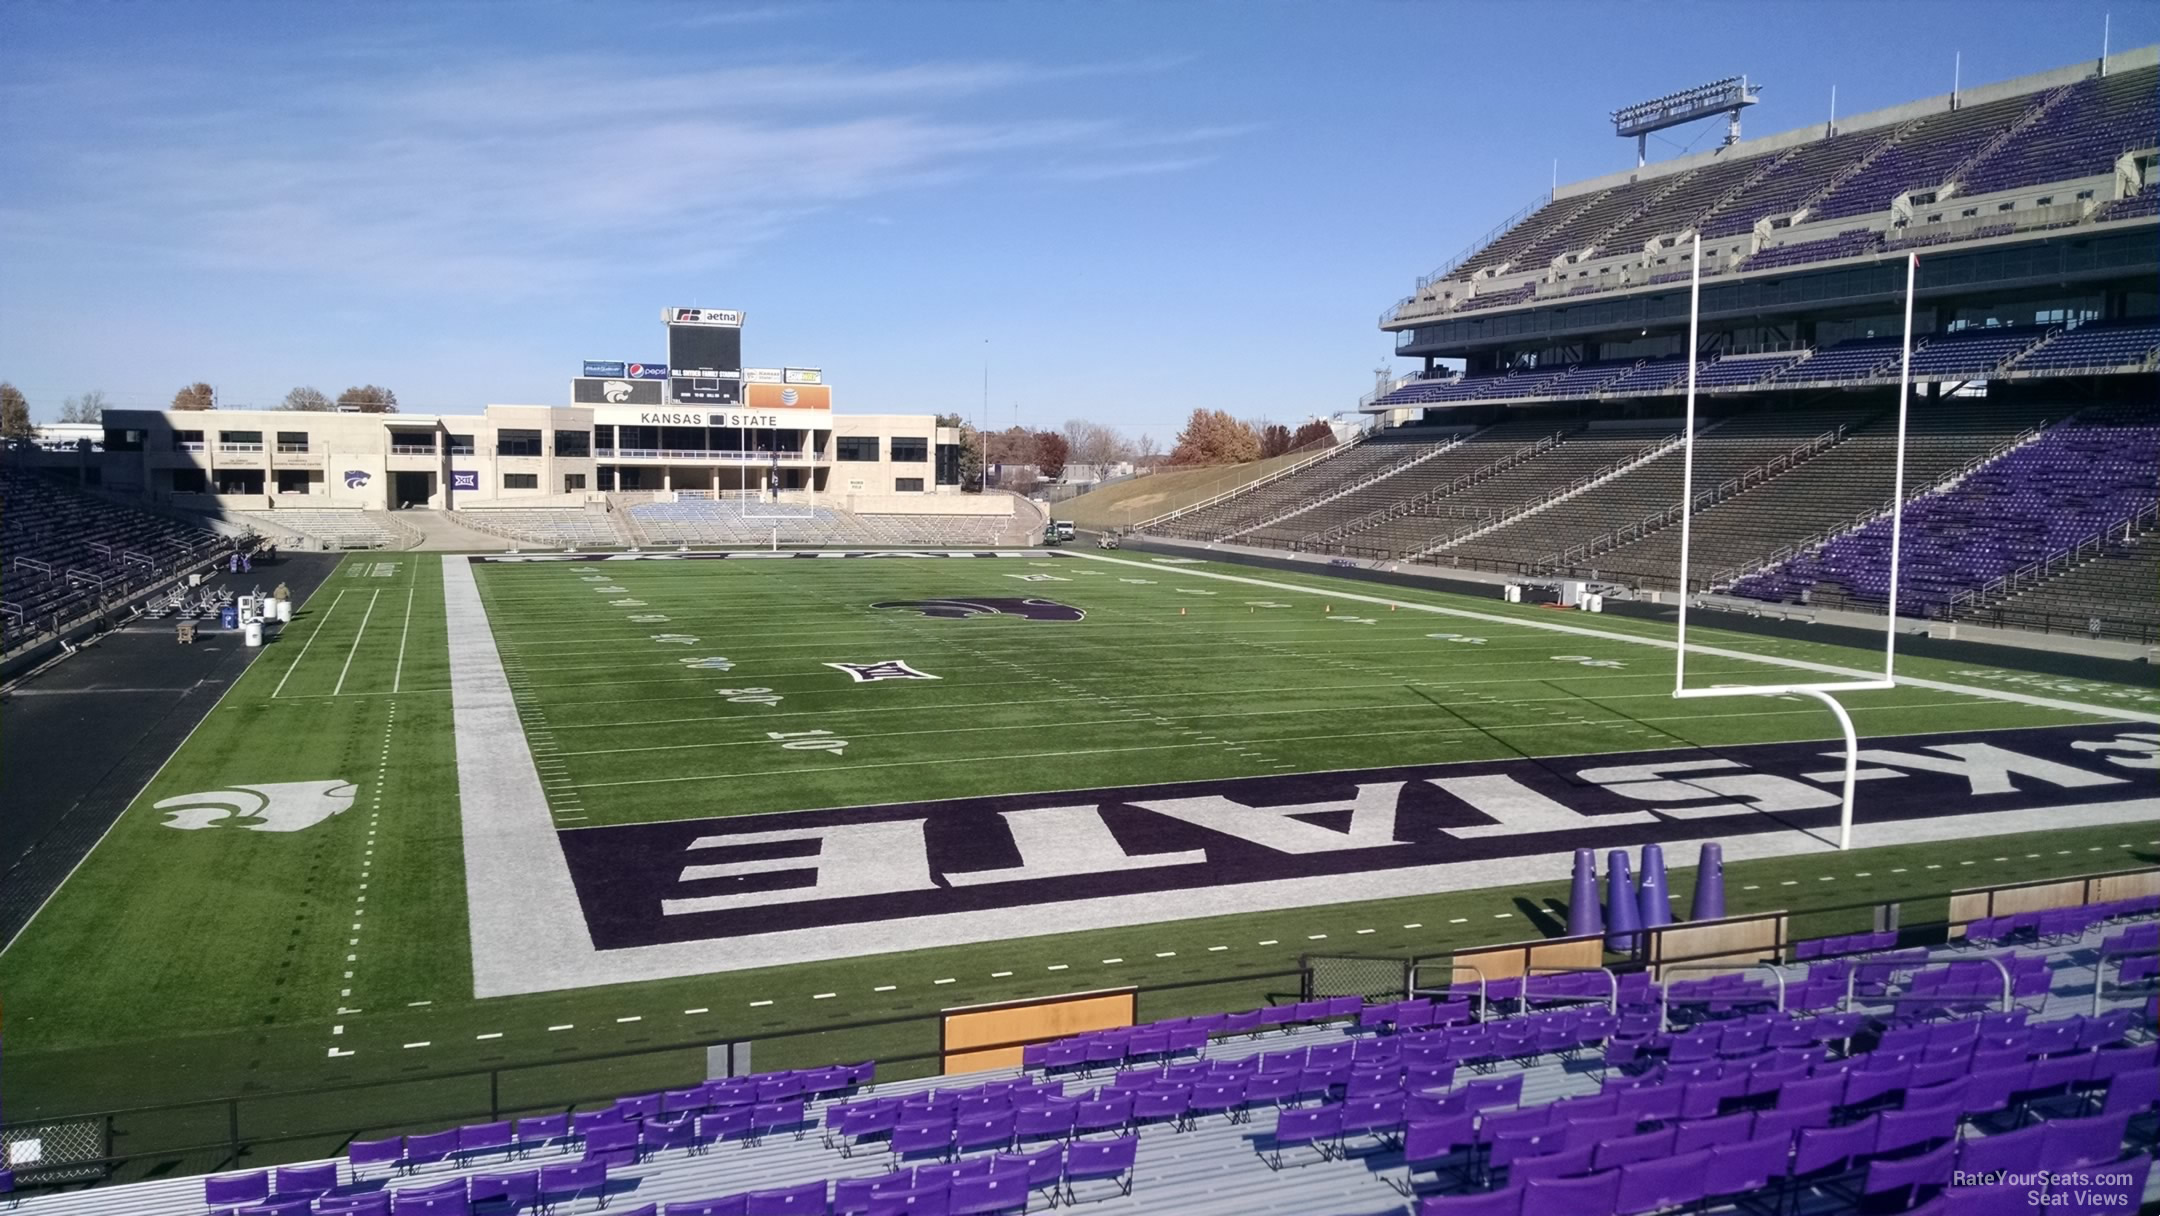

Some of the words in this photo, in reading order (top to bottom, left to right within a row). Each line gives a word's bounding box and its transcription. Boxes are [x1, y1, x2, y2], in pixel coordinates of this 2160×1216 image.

[707, 312, 736, 321] aetna
[641, 413, 701, 424] KANSAS
[732, 415, 776, 426] STATE
[715, 687, 784, 703] 20
[767, 729, 849, 750] 10
[661, 742, 2133, 916] K-STATE
